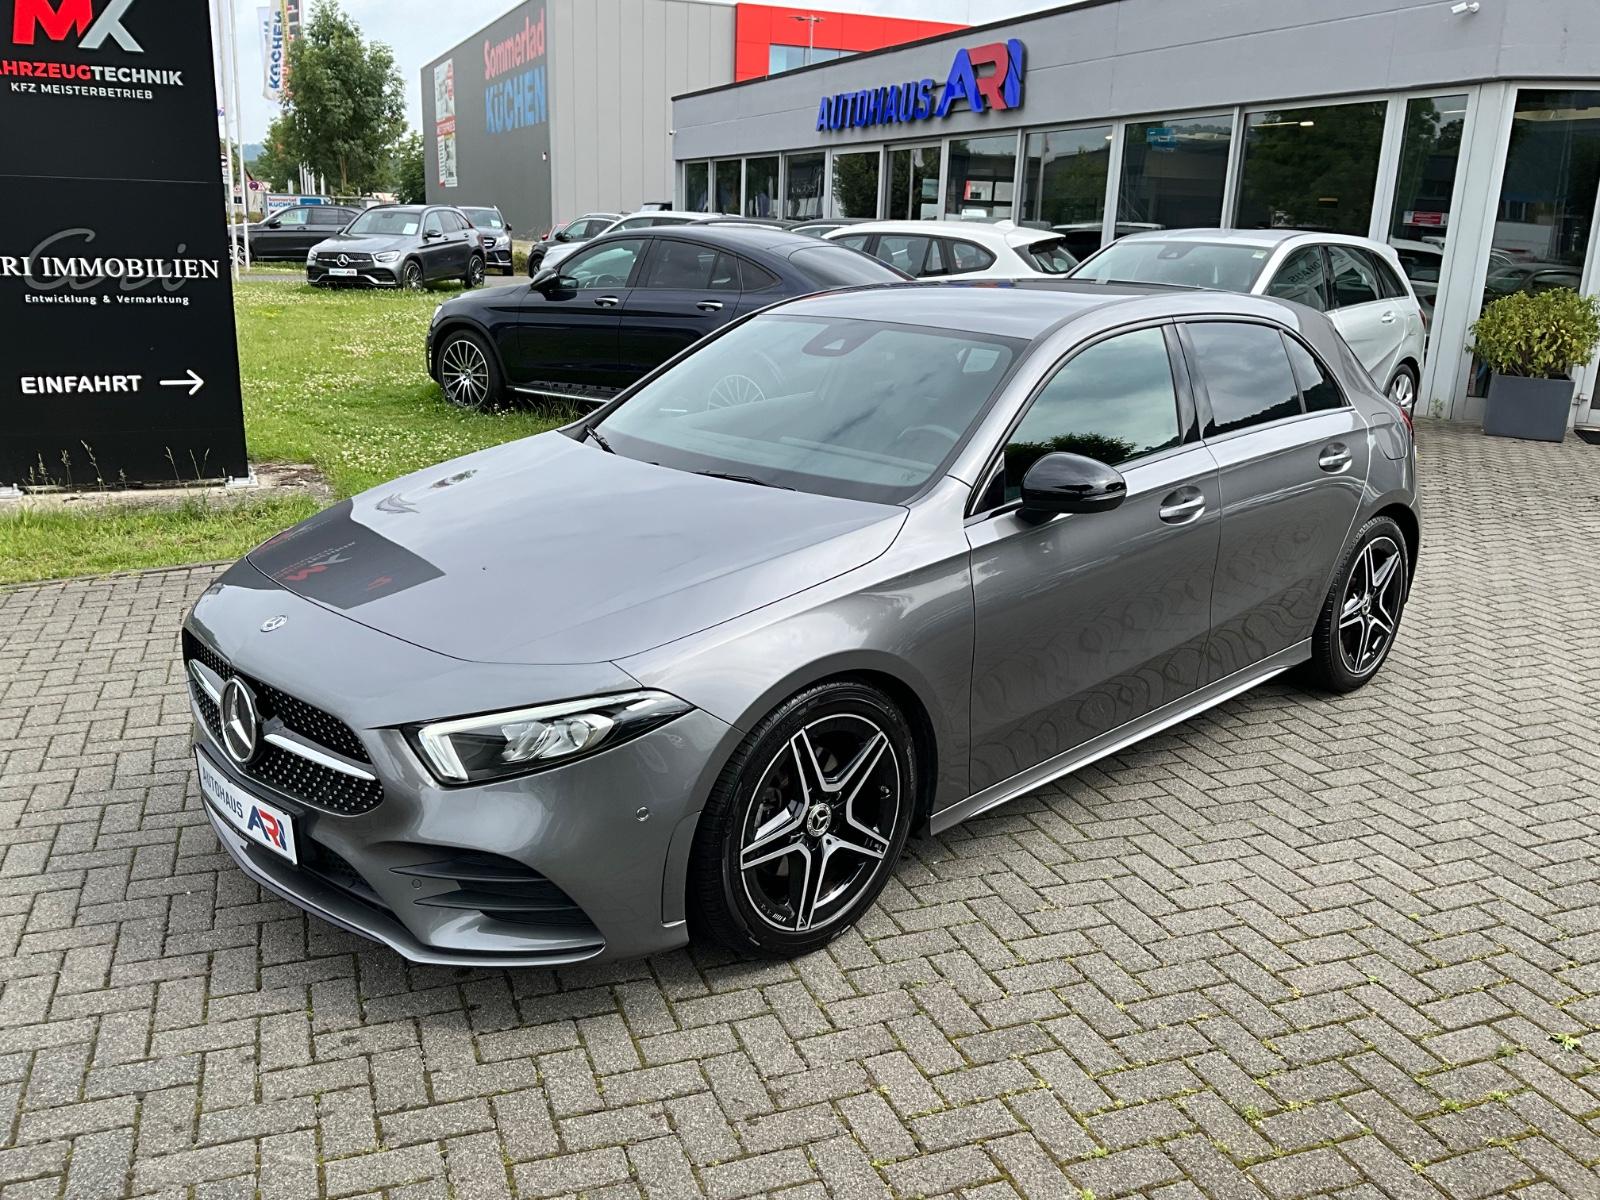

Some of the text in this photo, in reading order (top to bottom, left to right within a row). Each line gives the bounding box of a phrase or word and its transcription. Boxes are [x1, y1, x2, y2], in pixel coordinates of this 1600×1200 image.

[484, 9, 545, 80] Sommerlad
[0, 60, 183, 86] HRZEUGTECHNIK
[816, 38, 1027, 131] AUTOHAUS ARI
[10, 82, 153, 100] KFZ MEISTERBETRIEB
[0, 256, 219, 279] RI IMMOBILIEN
[24, 294, 190, 306] Entwicklung & Vermarktung
[21, 375, 142, 394] EINFAHRT
[202, 766, 244, 819] AUTOHAUS
[247, 805, 287, 851] ARI
